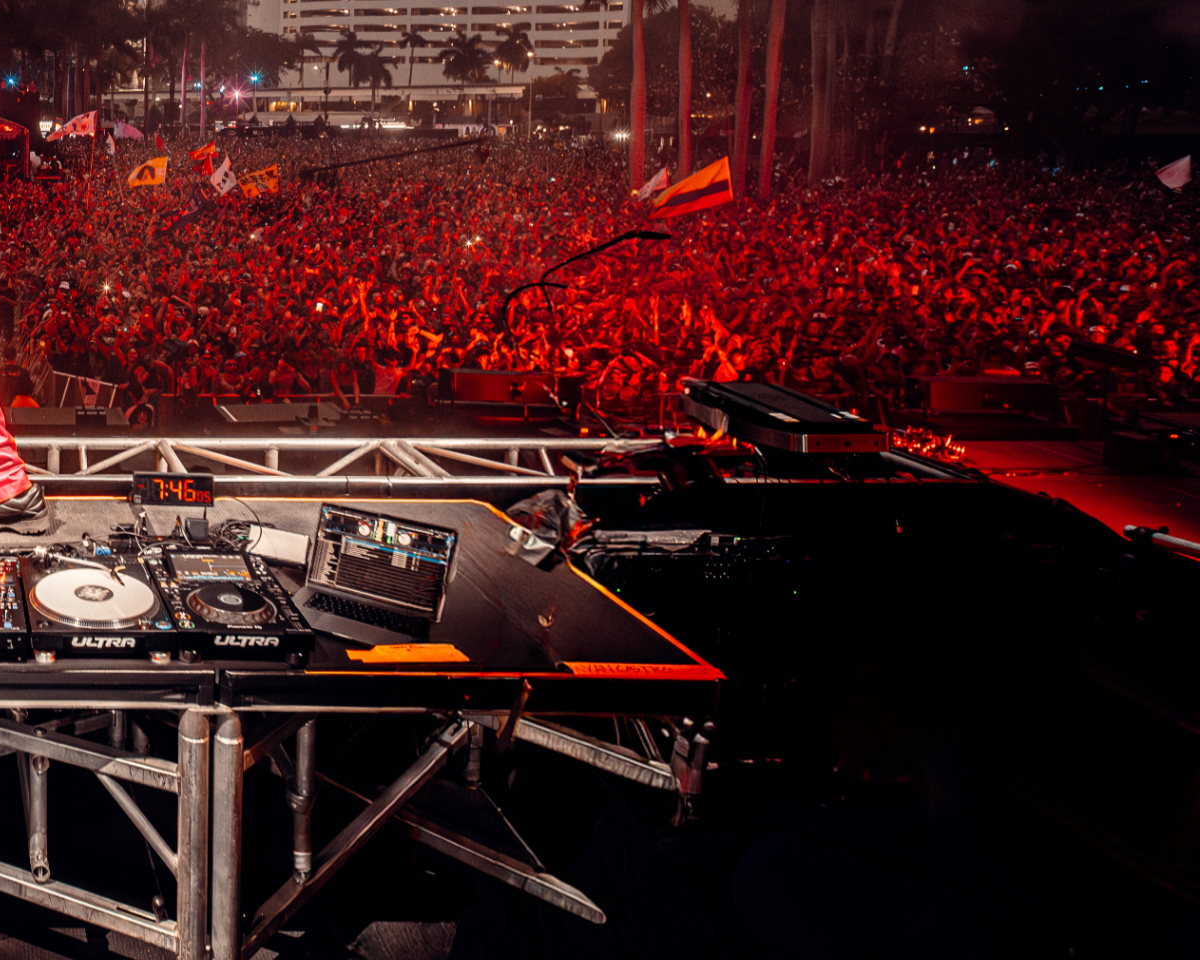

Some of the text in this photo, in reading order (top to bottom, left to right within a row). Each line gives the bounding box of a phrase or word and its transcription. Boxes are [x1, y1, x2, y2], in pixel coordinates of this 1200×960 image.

[152, 478, 196, 502] 7:46
[71, 636, 136, 648] ULTRA
[214, 635, 280, 648] ULTRA
